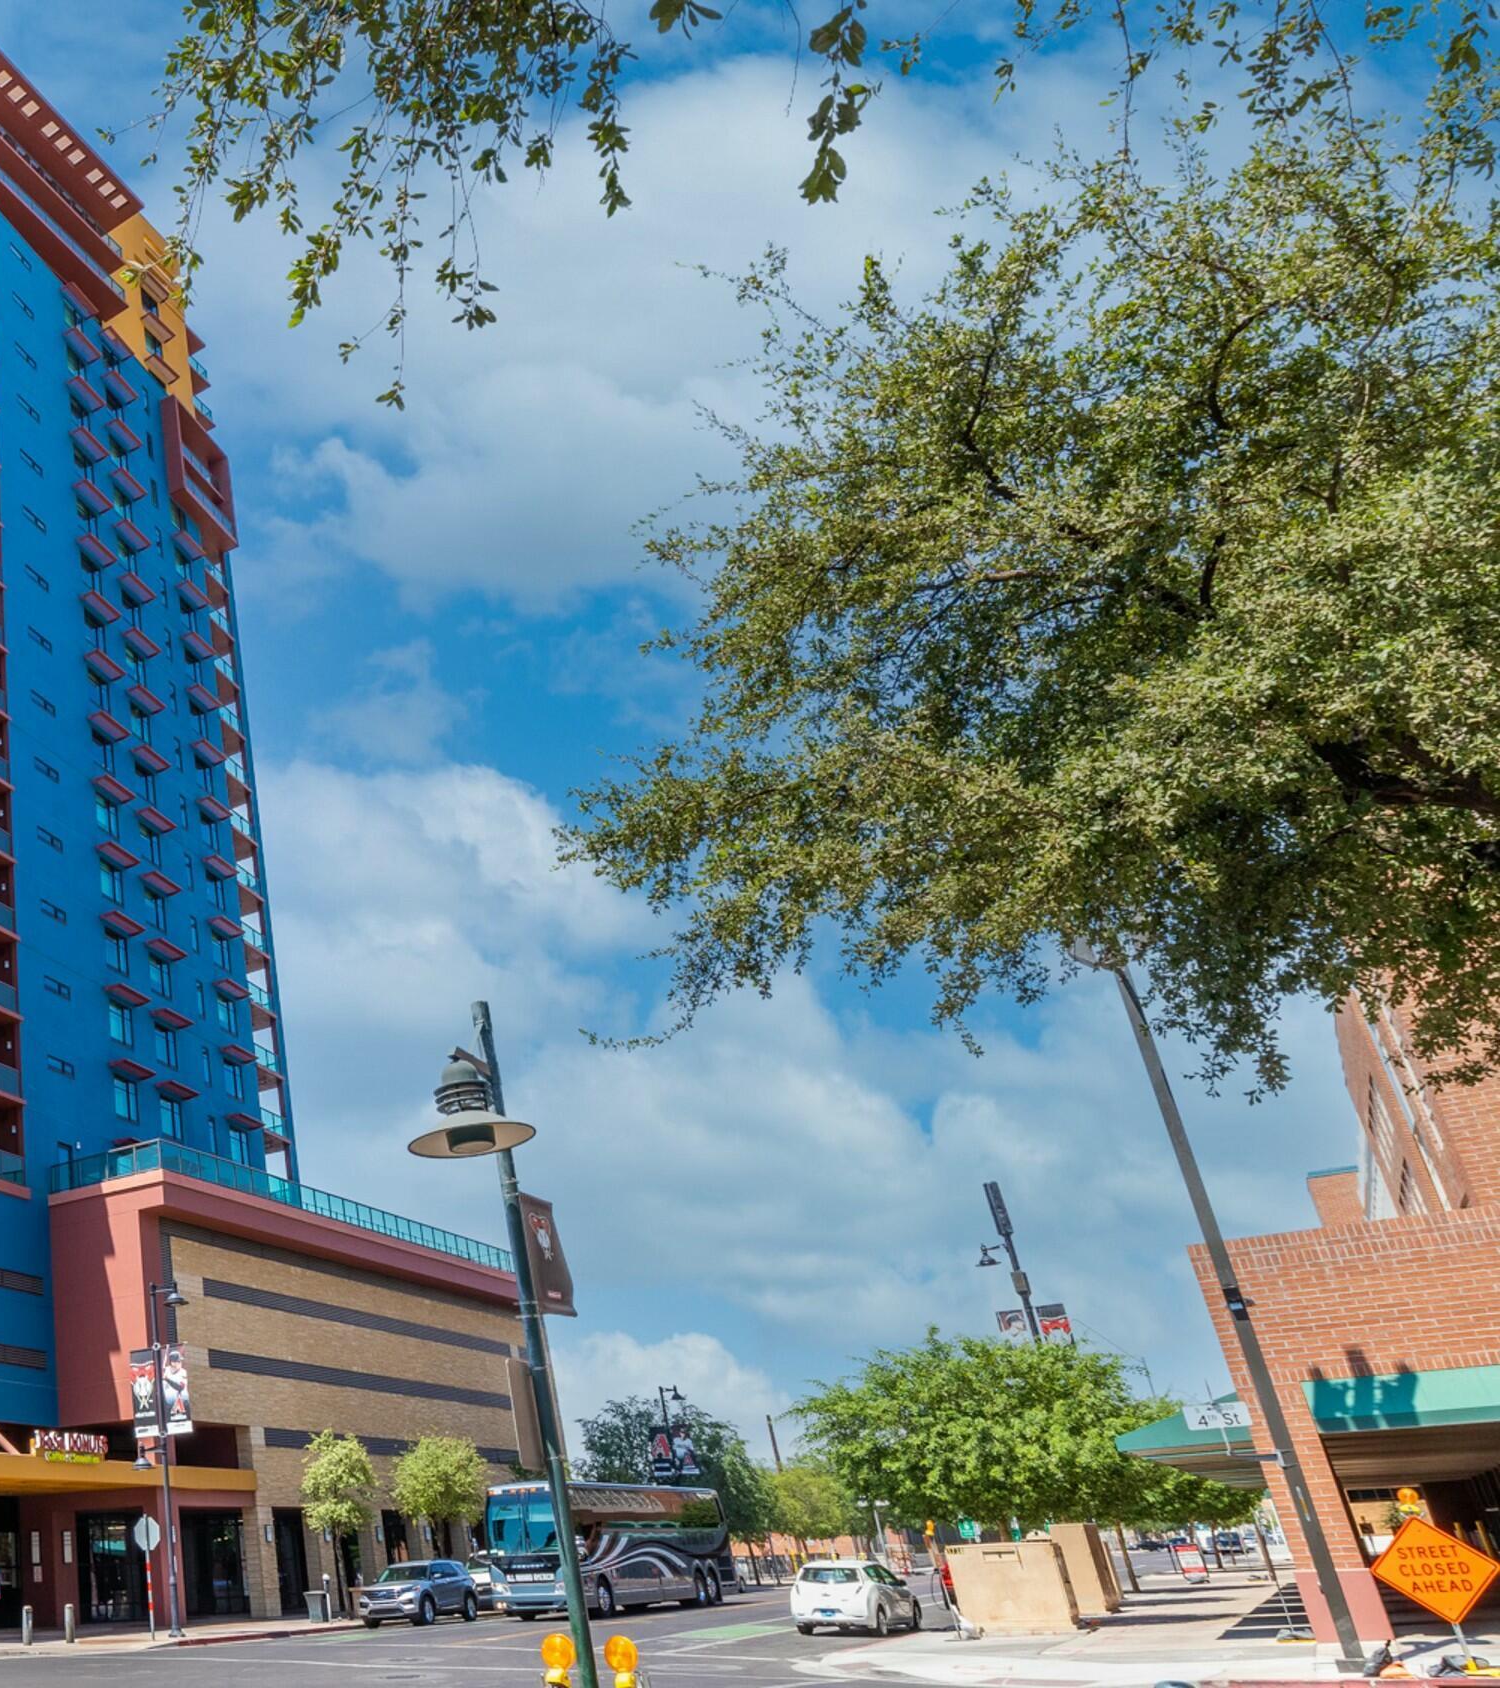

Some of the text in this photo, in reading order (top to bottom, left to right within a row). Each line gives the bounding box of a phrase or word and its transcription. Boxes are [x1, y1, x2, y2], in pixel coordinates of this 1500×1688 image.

[1222, 1412, 1241, 1426] St
[1397, 1545, 1458, 1560] STREET
[1399, 1561, 1470, 1577] CLOSED
[1412, 1579, 1473, 1593] AHEAD
